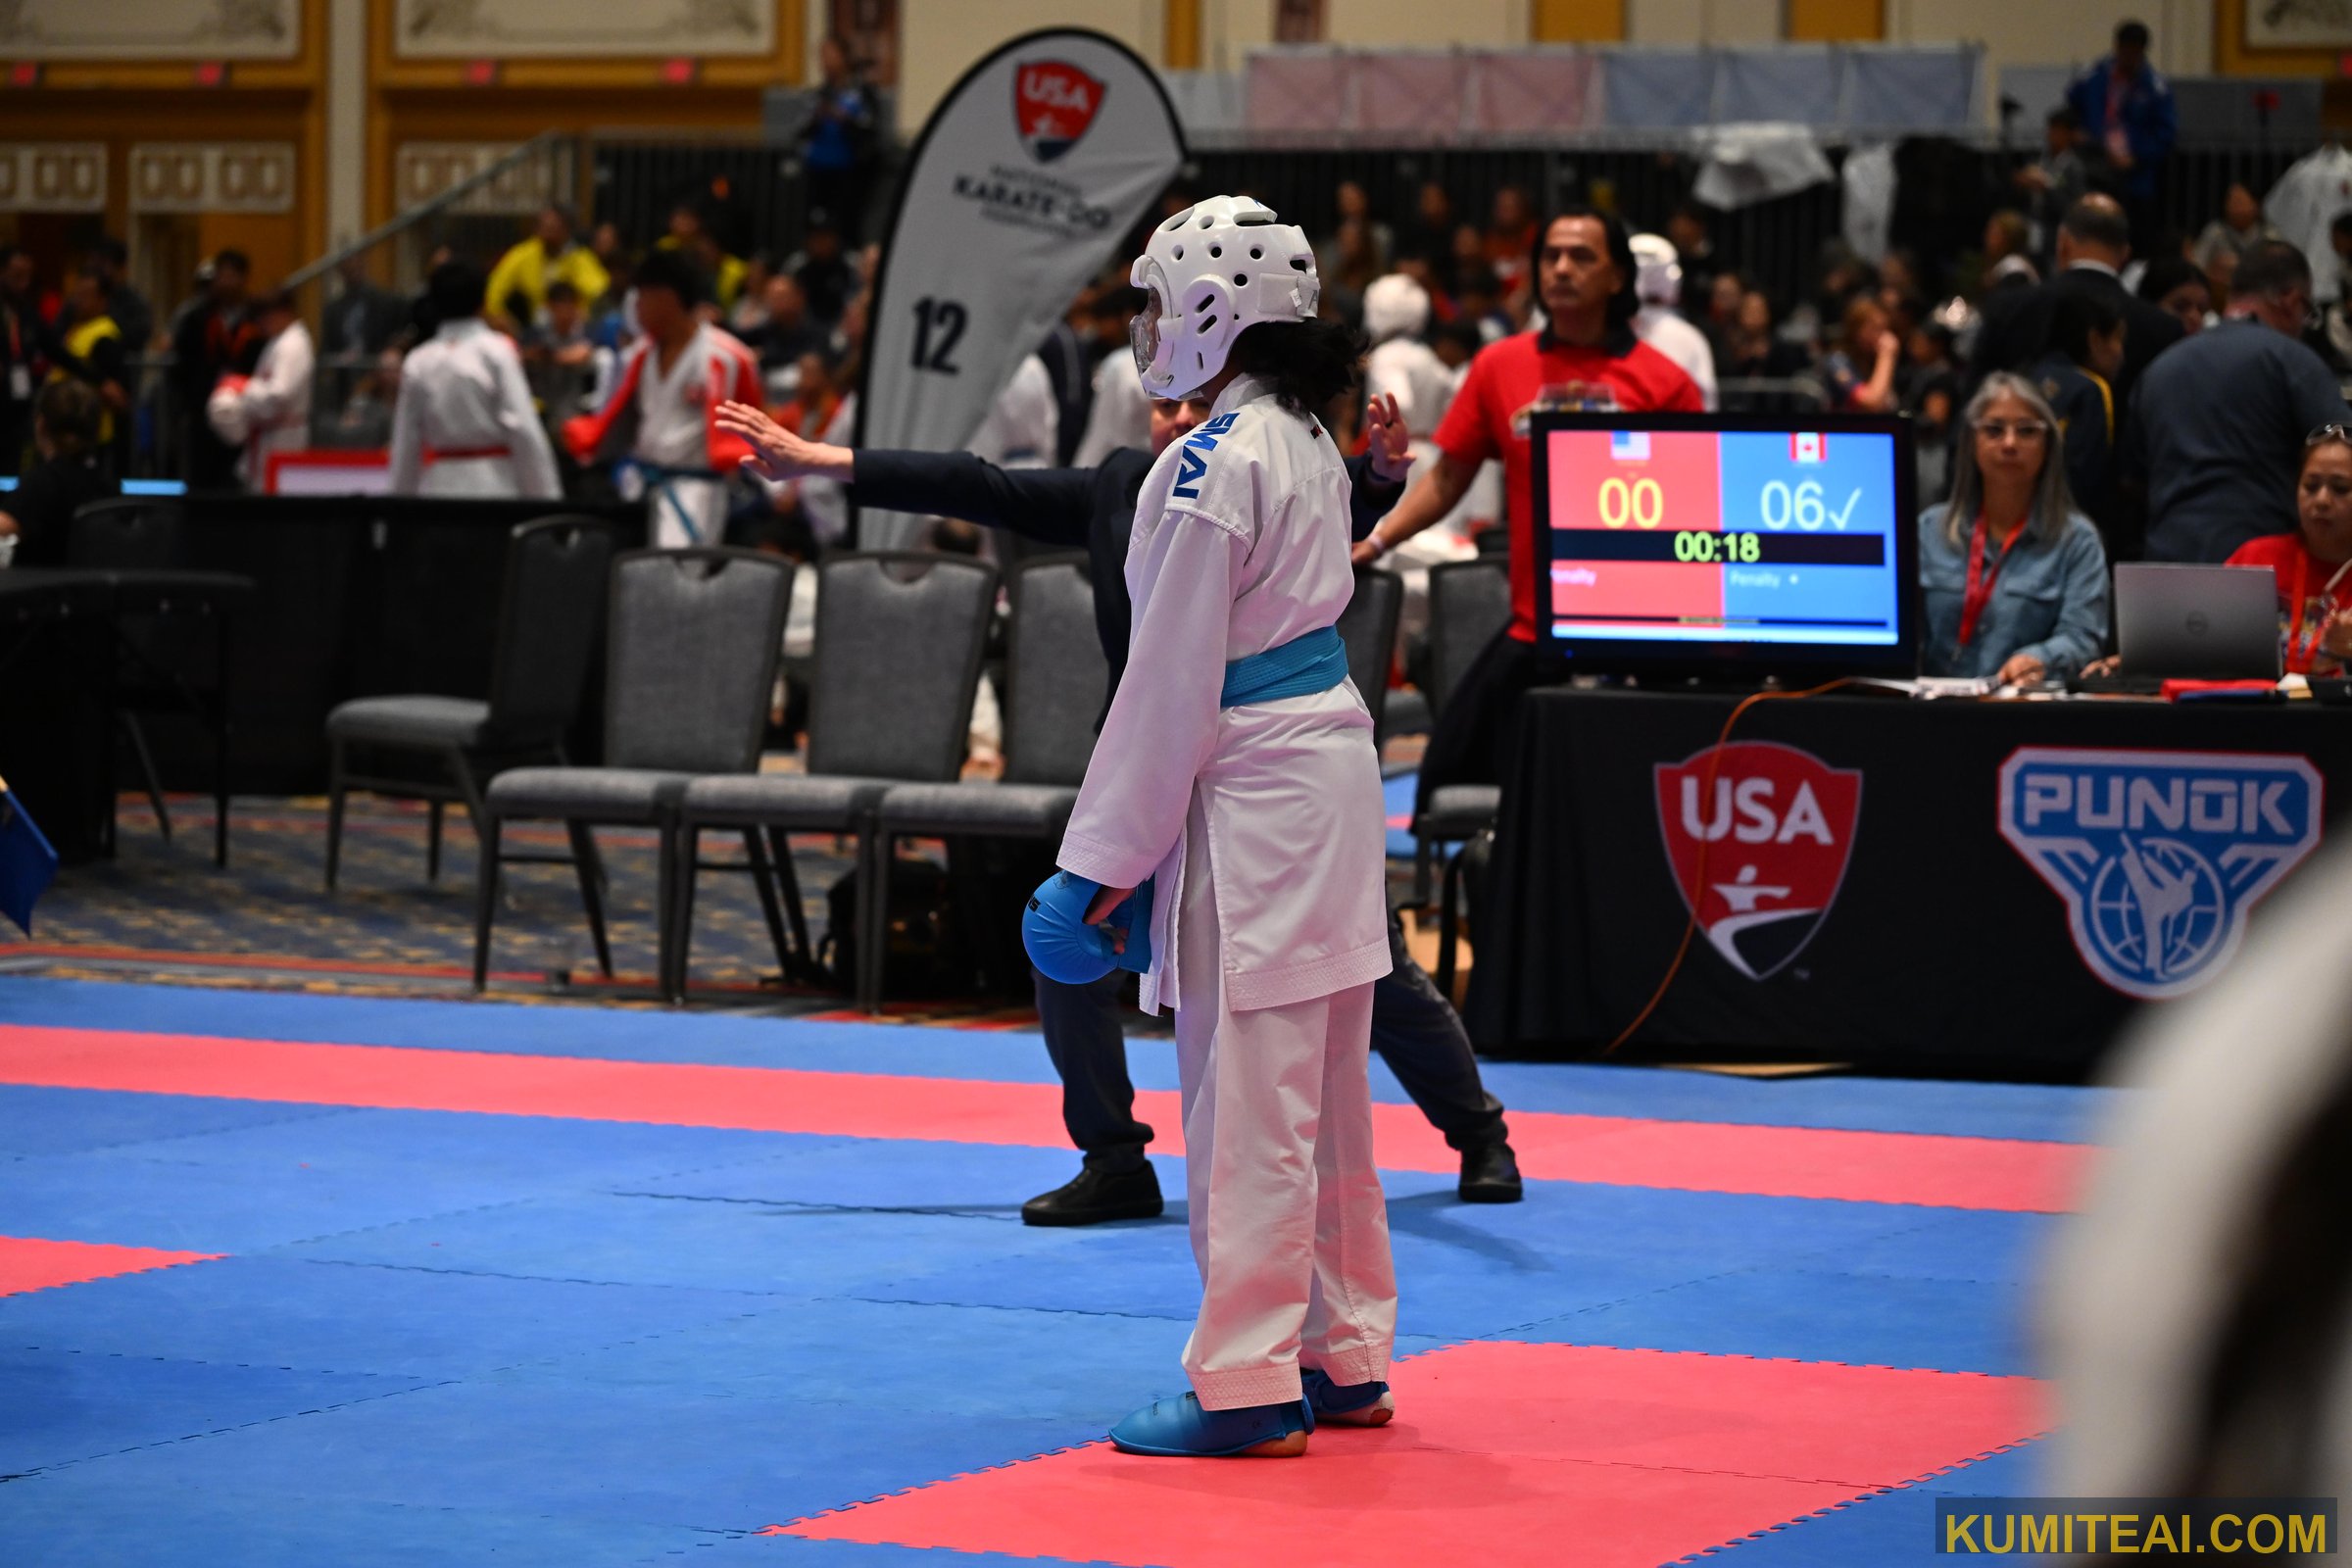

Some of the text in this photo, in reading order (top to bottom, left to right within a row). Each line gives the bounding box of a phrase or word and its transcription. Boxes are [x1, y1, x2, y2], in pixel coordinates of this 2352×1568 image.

[1023, 70, 1088, 112] USA
[910, 296, 968, 375] 12
[1172, 413, 1240, 500] SMAI
[1598, 477, 1663, 529] 00
[1760, 480, 1825, 531] 06
[1674, 530, 1760, 563] 00:18
[1730, 569, 1781, 590] Penalty
[1681, 776, 1835, 846] USA
[2024, 774, 2295, 836] PUNOK
